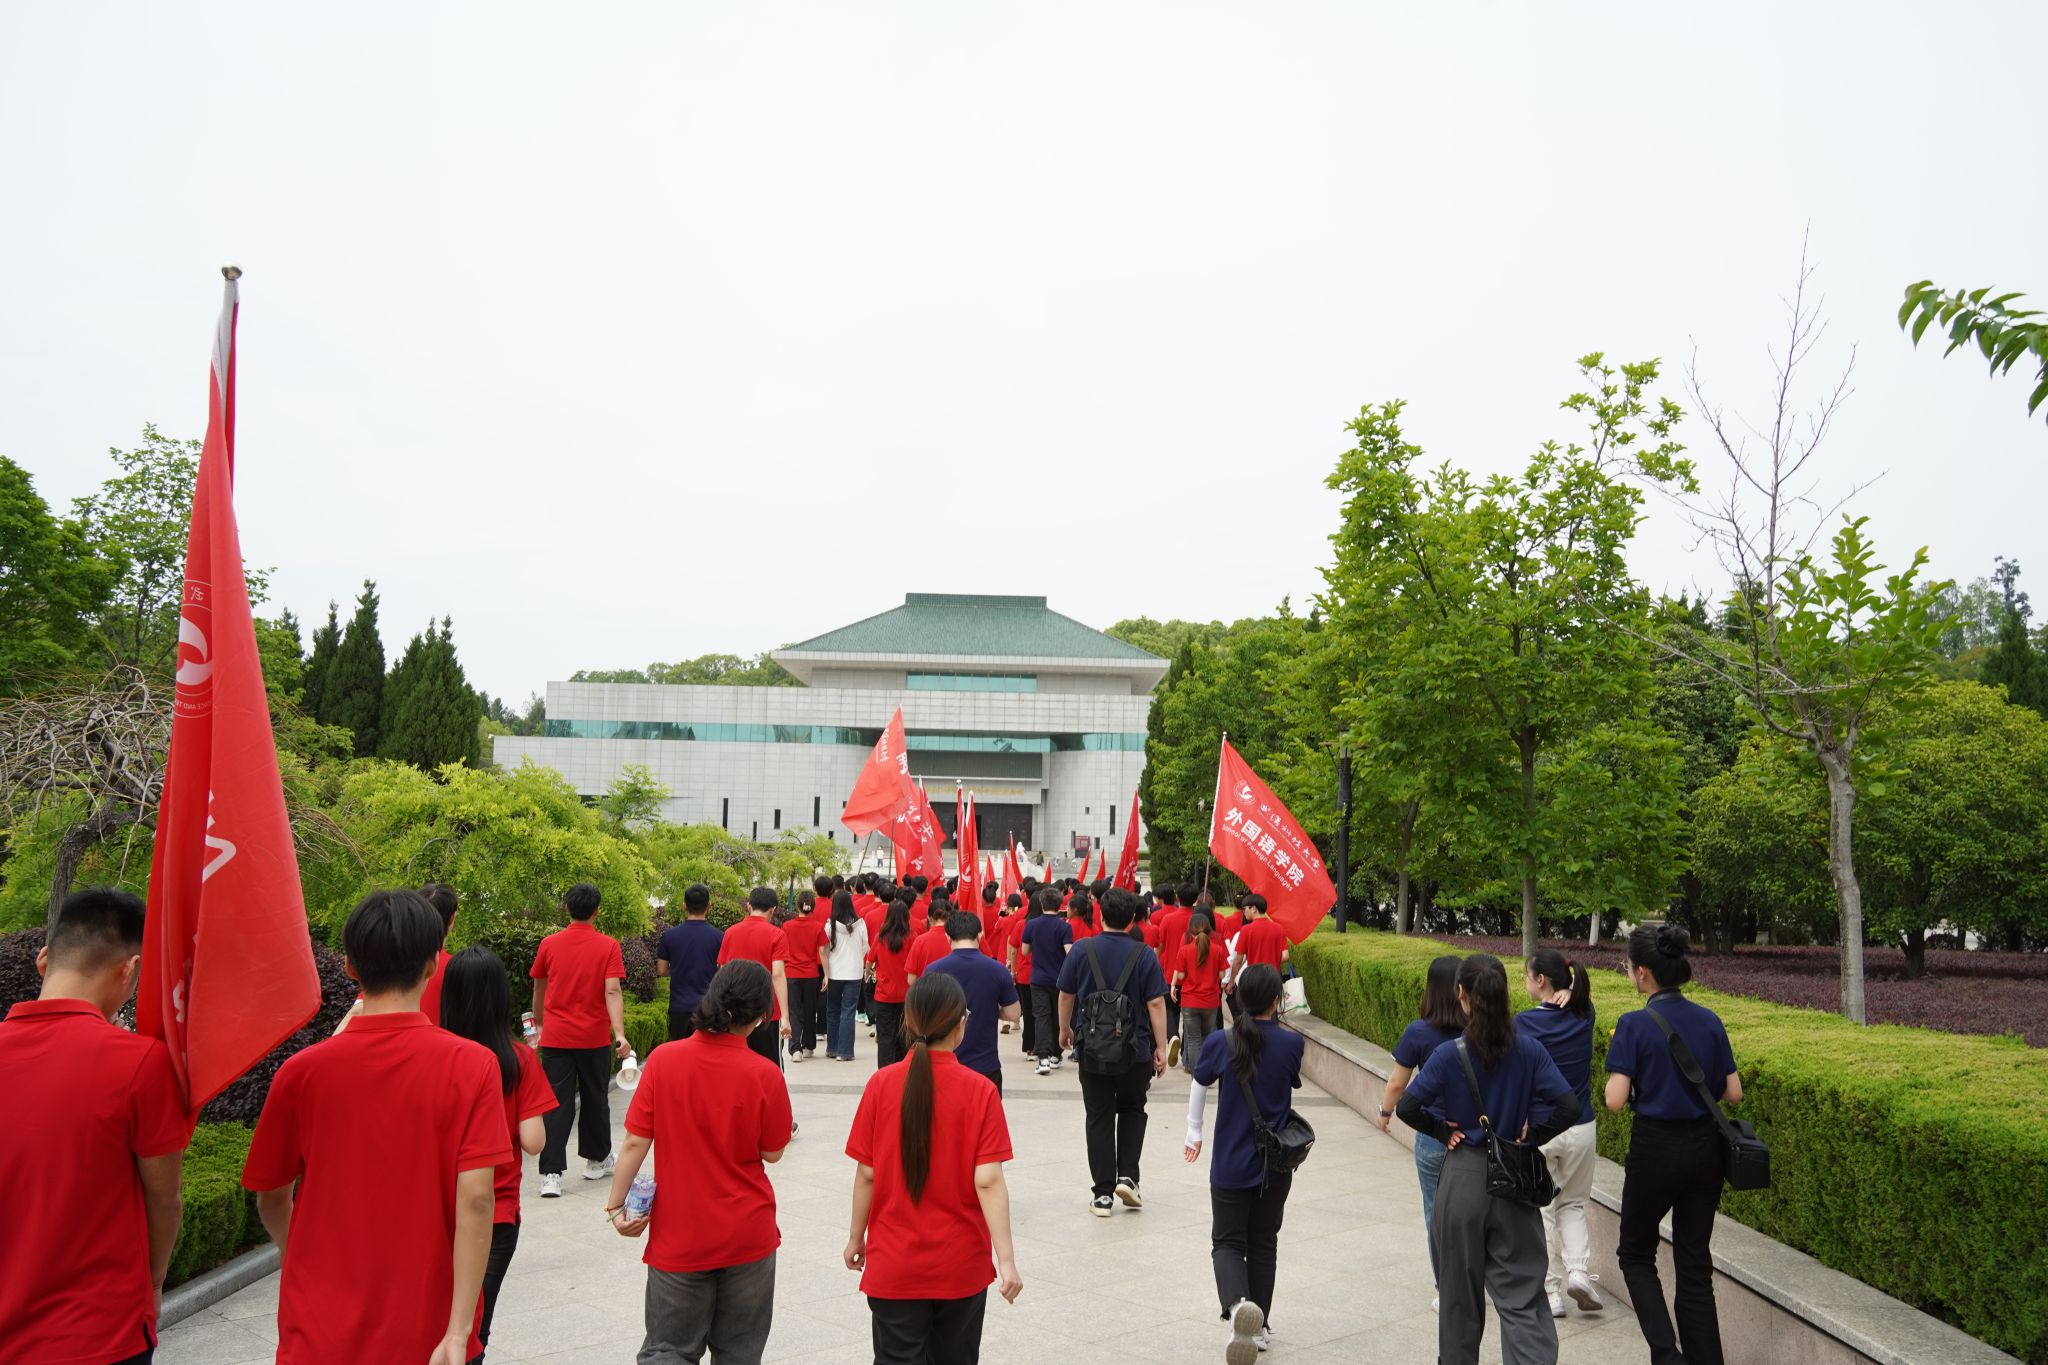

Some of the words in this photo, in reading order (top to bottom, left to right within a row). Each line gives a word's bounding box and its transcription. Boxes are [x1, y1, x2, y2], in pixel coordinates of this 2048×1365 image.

[1222, 823, 1240, 840] School
[1247, 840, 1268, 863] Foreign
[1267, 860, 1293, 892] Languages
[1224, 807, 1305, 887] 外国语学院
